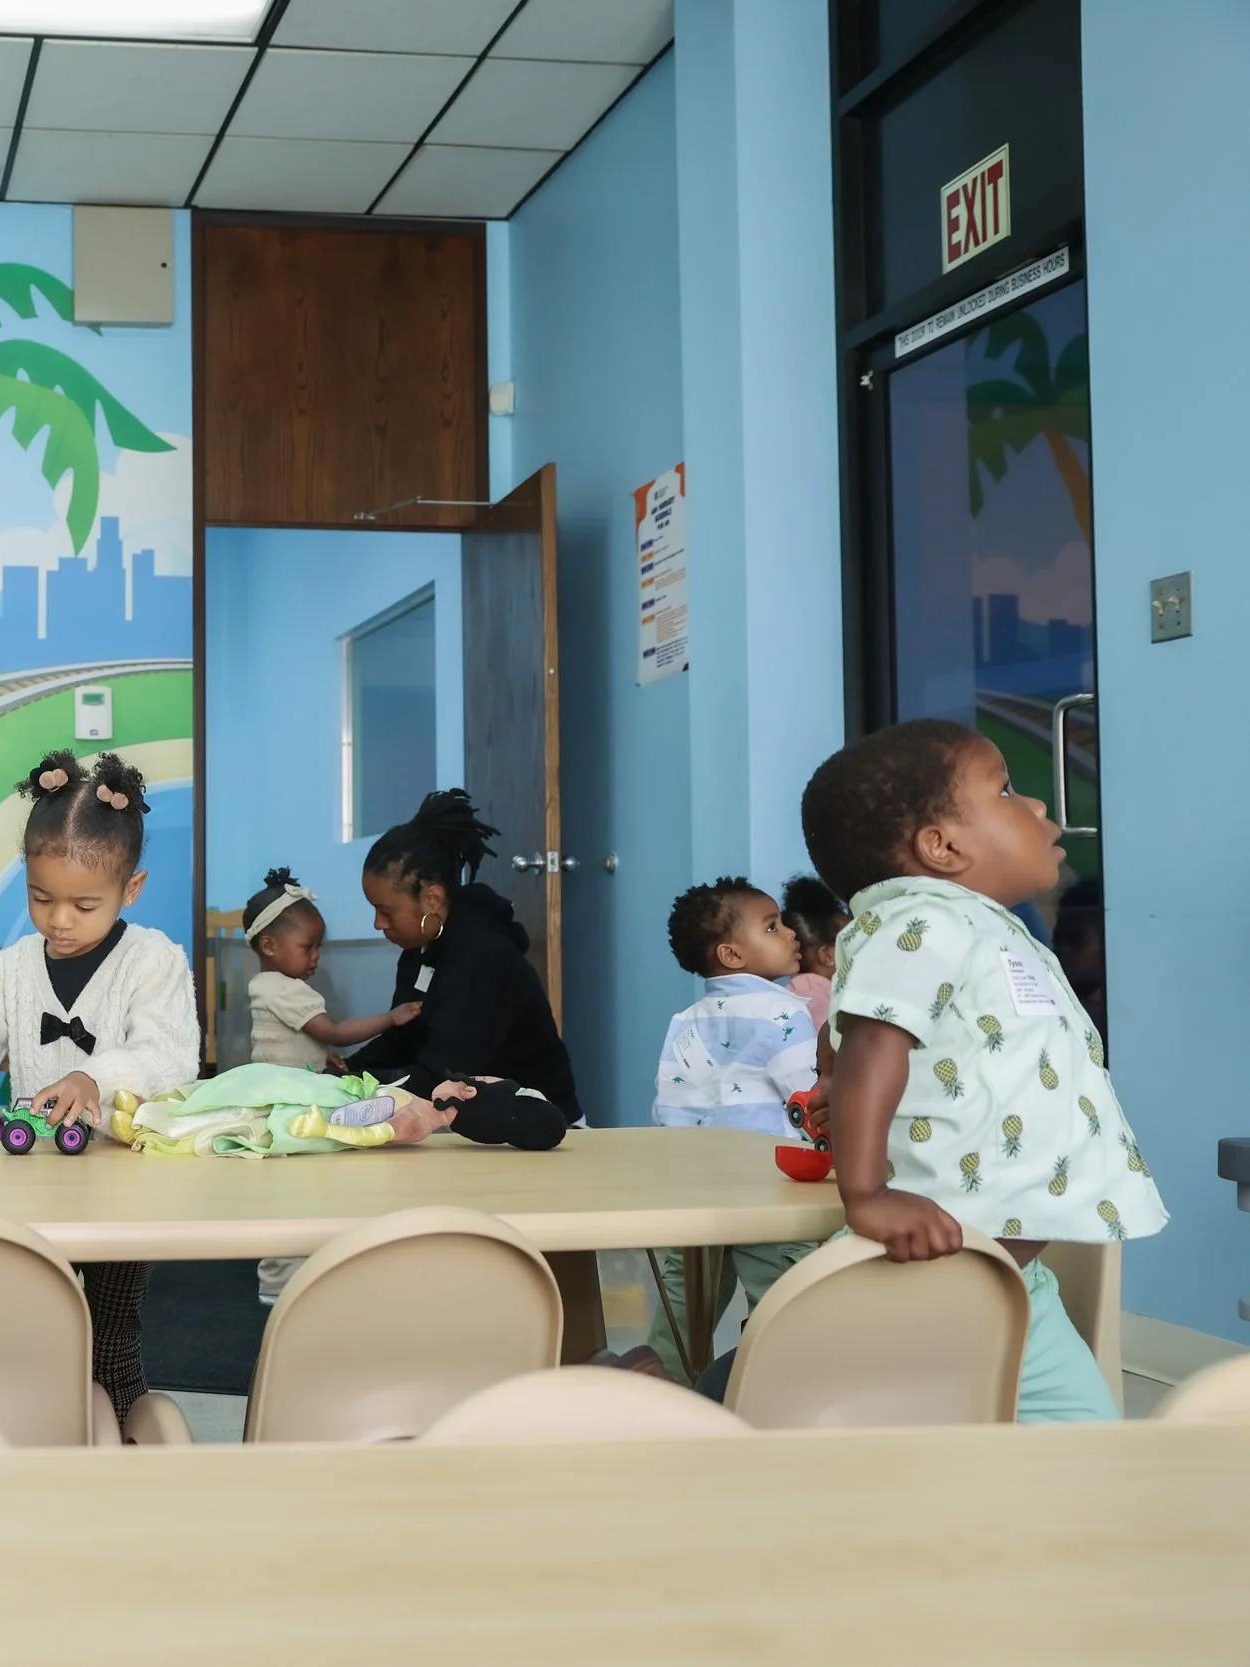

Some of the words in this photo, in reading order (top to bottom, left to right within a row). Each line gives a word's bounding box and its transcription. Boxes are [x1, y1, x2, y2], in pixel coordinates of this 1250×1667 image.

[946, 159, 1004, 264] EXIT
[898, 333, 910, 347] THIS
[911, 325, 926, 343] DOOR
[927, 320, 934, 334] TO
[935, 310, 956, 329] REMAIN
[957, 293, 986, 319] UNLOCKED
[987, 281, 1010, 304] DURING
[1011, 265, 1041, 291] BUSINESS
[1042, 252, 1066, 274] HOURS
